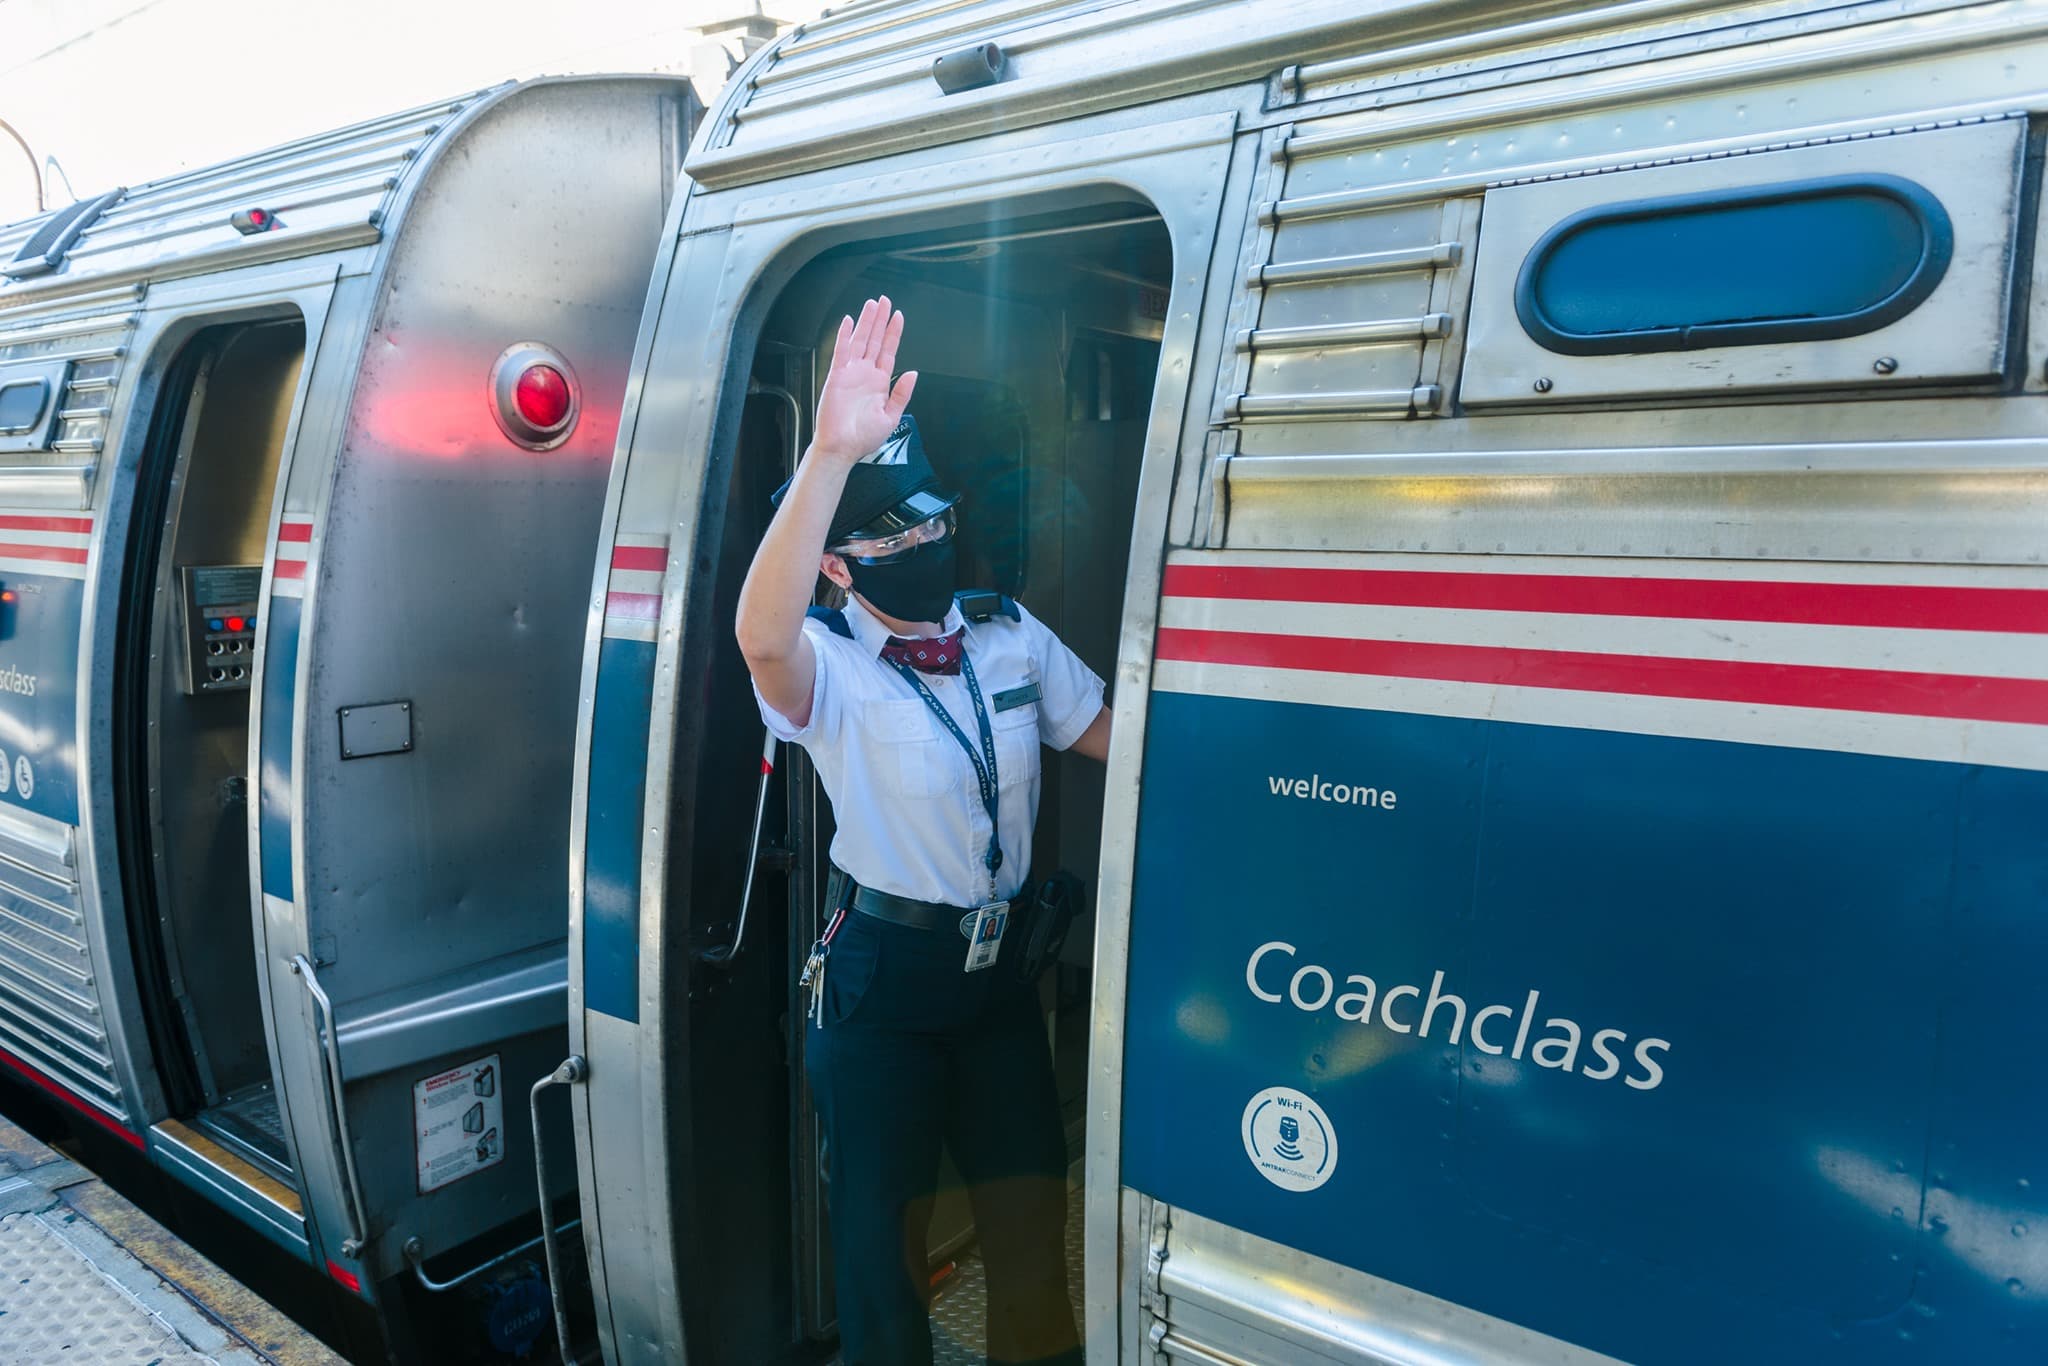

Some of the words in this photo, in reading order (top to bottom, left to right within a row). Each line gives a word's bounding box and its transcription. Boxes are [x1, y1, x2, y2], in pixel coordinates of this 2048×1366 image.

[926, 696, 957, 732] AMTRAK
[984, 735, 997, 780] AMTRAK
[1268, 773, 1397, 810] welcome
[1245, 940, 1671, 1091] Coachclass
[1276, 1096, 1303, 1112] Wi-Fi
